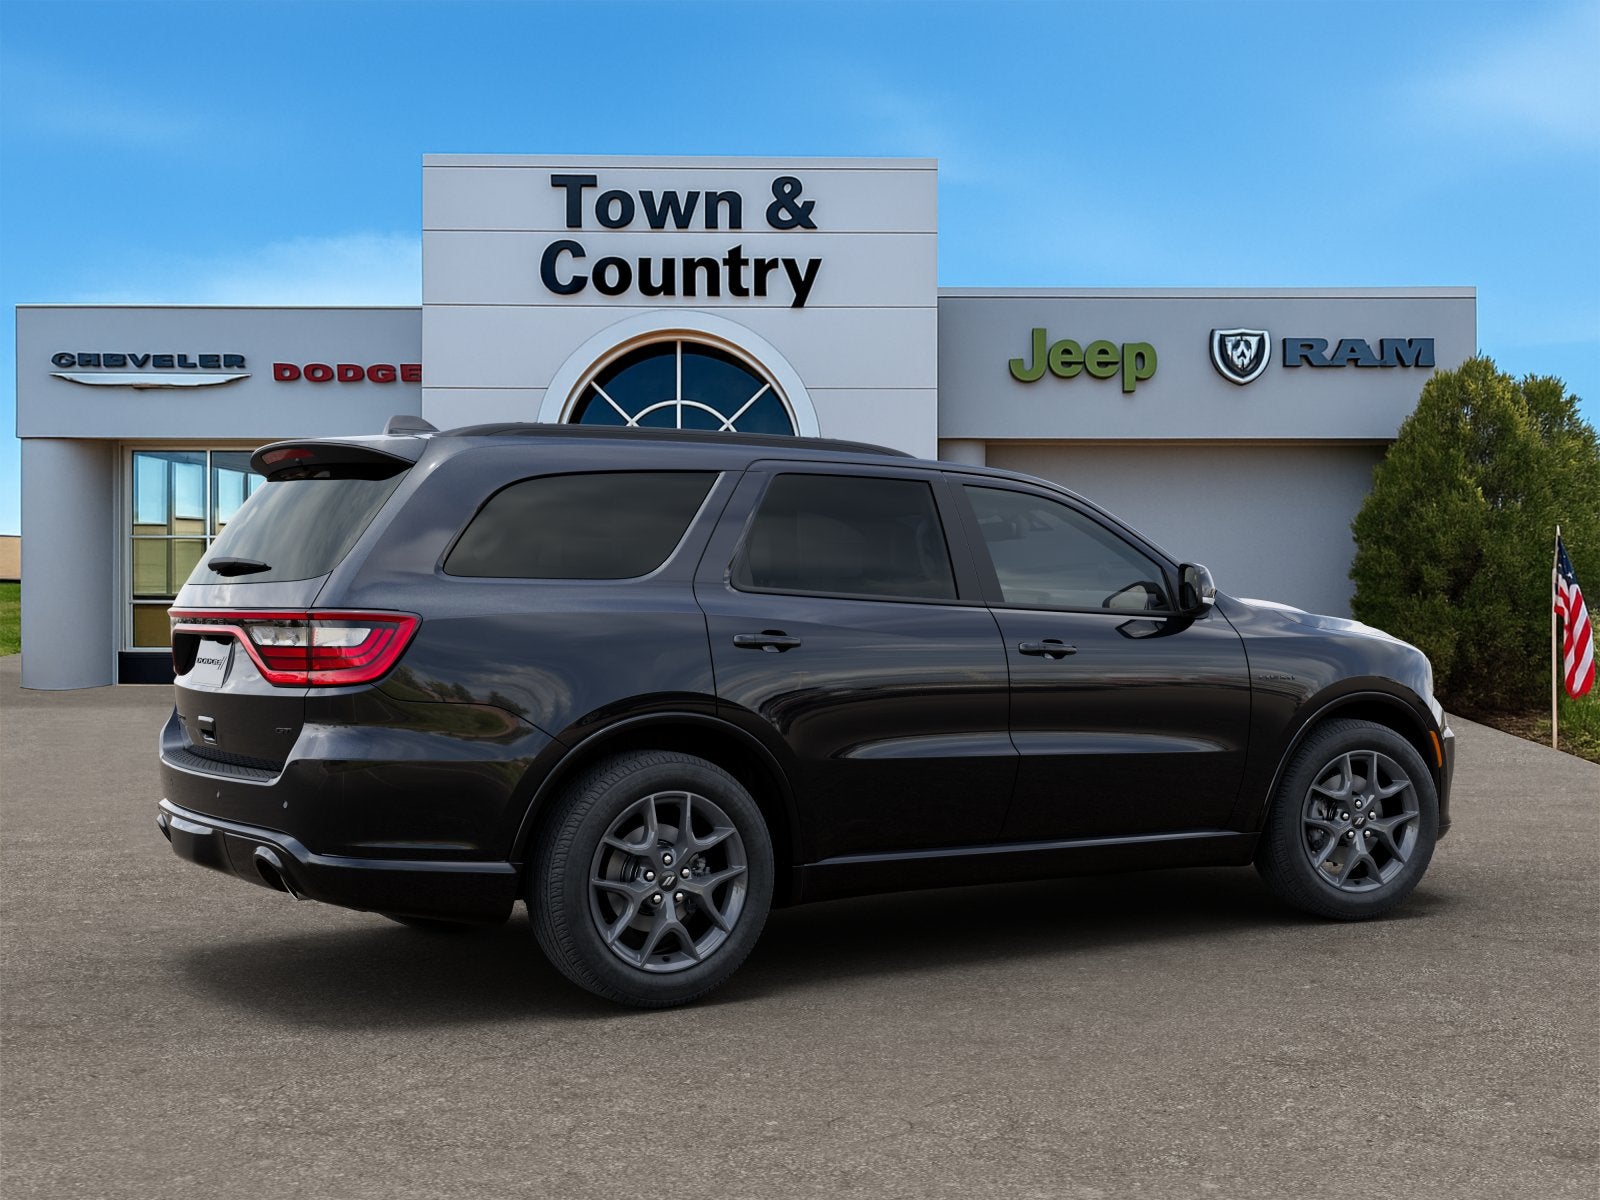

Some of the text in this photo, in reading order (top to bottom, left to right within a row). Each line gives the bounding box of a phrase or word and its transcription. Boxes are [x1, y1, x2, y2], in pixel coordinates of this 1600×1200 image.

[551, 174, 818, 229] Town &
[540, 239, 822, 308] Country
[273, 363, 422, 383] DODGE
[1009, 328, 1157, 393] Jeep
[1283, 337, 1435, 367] RAM
